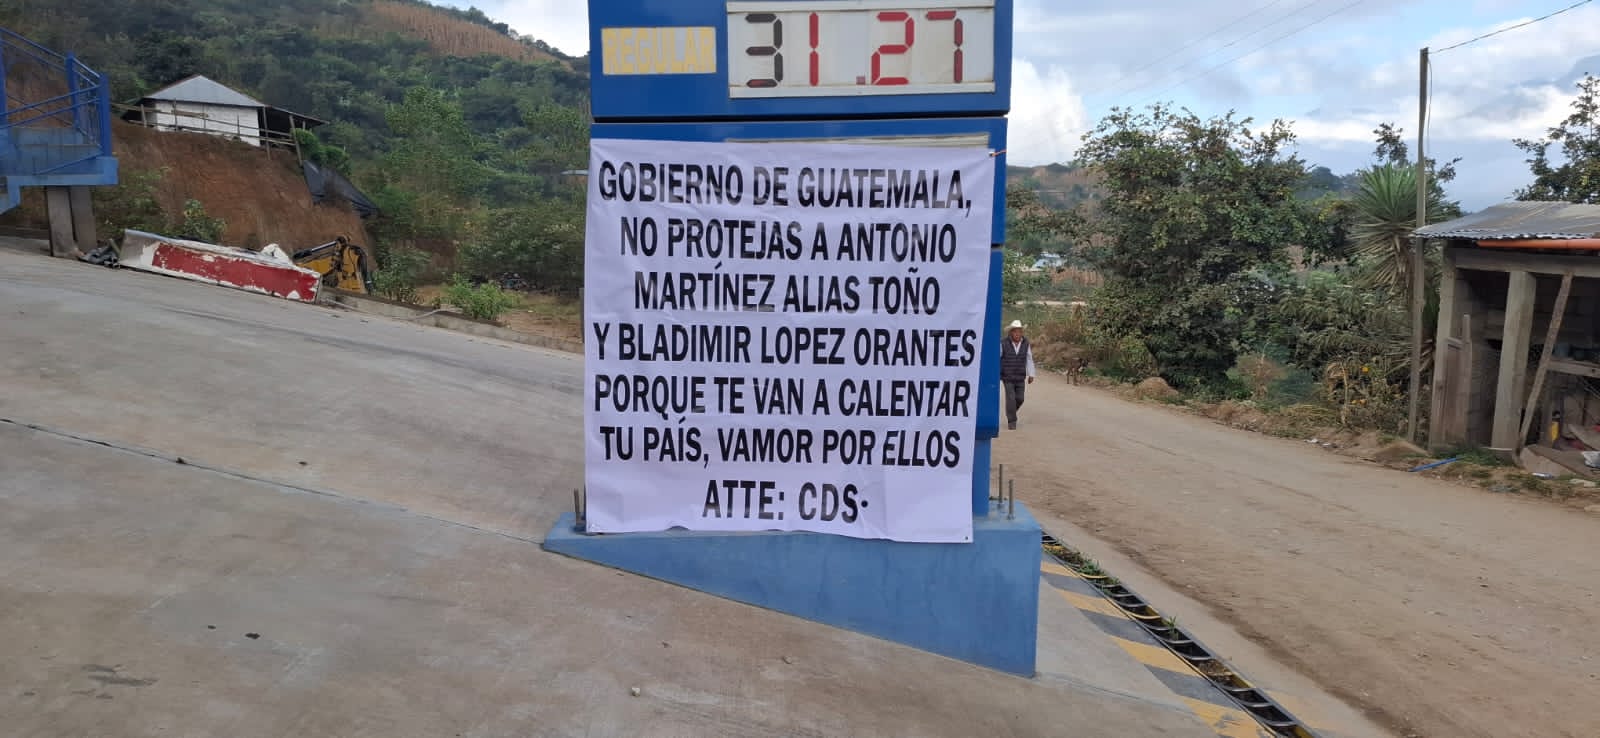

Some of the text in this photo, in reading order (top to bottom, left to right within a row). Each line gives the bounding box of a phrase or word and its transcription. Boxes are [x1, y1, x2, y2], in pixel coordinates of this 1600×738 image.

[603, 27, 715, 74] REGULAR
[599, 161, 971, 217] GOBIERNO DE GUATEMALA,
[621, 217, 956, 263] NO PROTEJAS A ANTONIO
[635, 261, 940, 315] MARTÍNEZ ALIAS TOÑO
[593, 323, 976, 367] Y BLADIMIR LOPEZ ORANTES
[595, 374, 970, 419] PORQUE TE VAN A CALENTAR
[600, 417, 960, 469] TU PAÍS, VAMOR POR ELLOS
[703, 480, 784, 520] ATTE:
